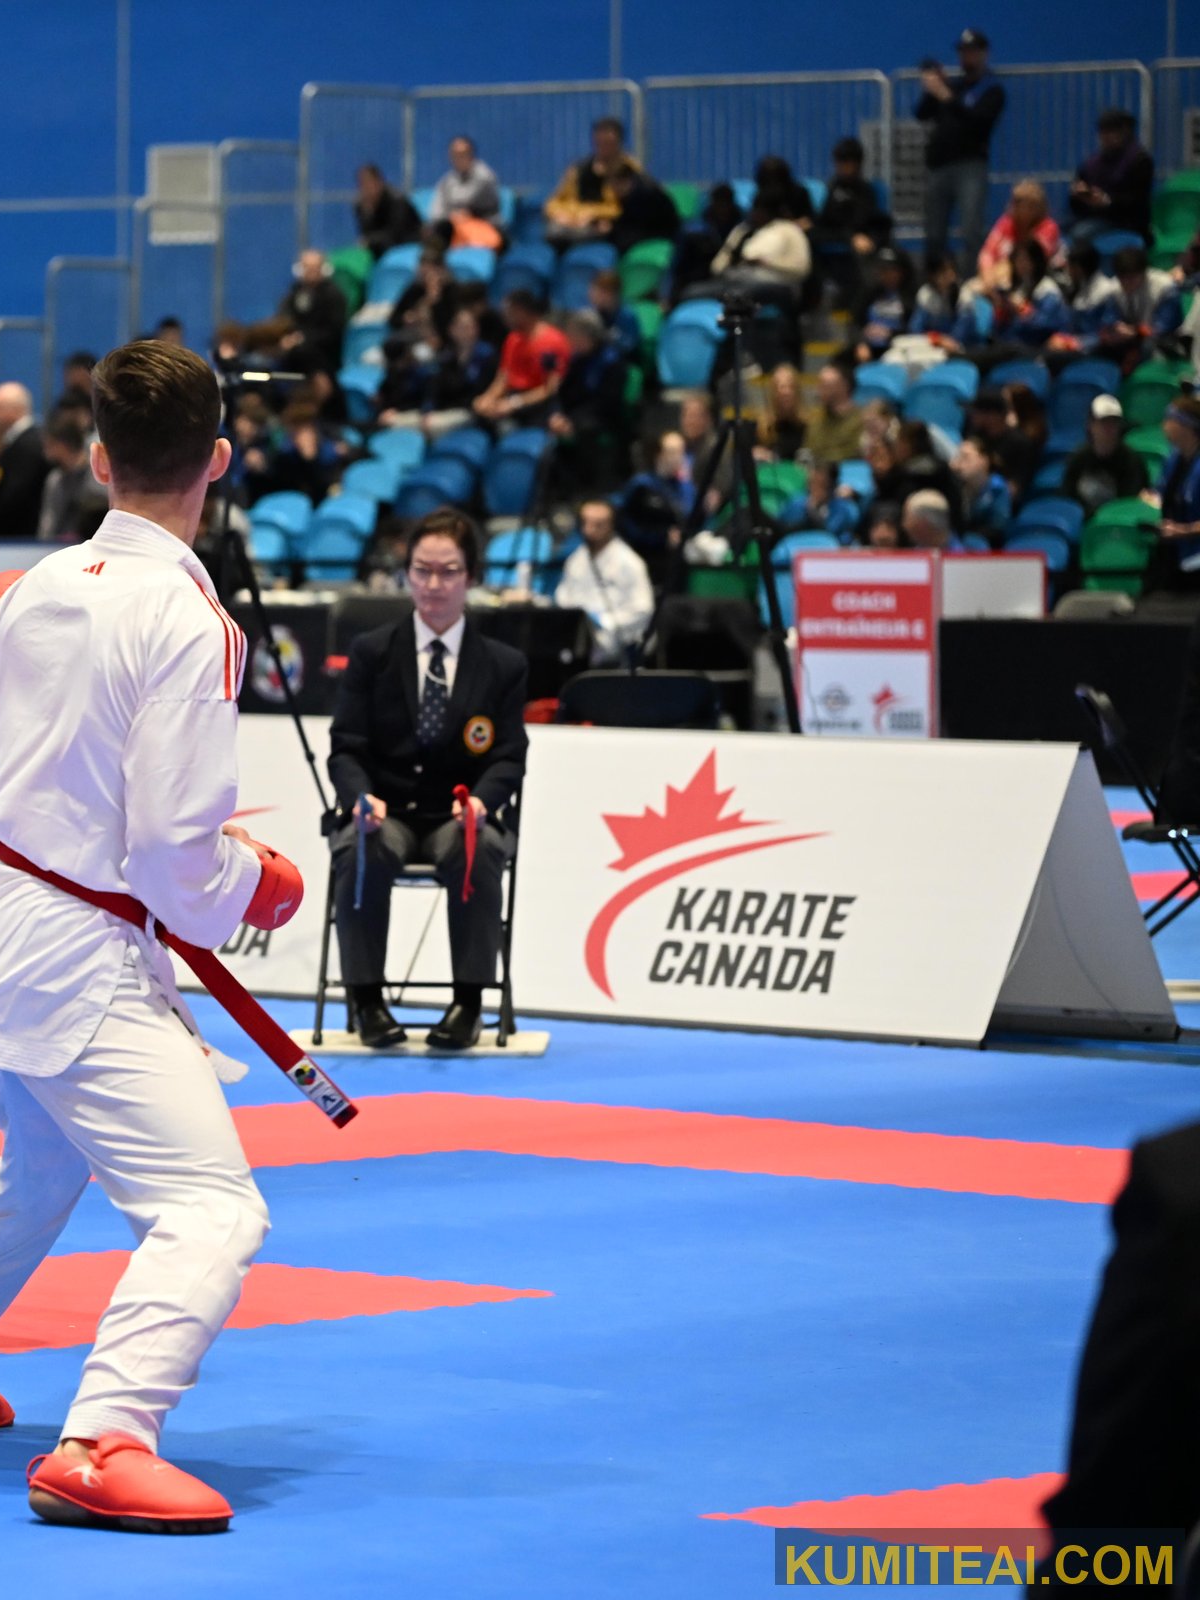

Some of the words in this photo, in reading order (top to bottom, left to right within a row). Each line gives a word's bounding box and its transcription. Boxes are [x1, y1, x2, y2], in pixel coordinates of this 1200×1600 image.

[832, 591, 896, 612] COACH
[666, 886, 857, 940] KARATE
[649, 940, 835, 994] CANADA
